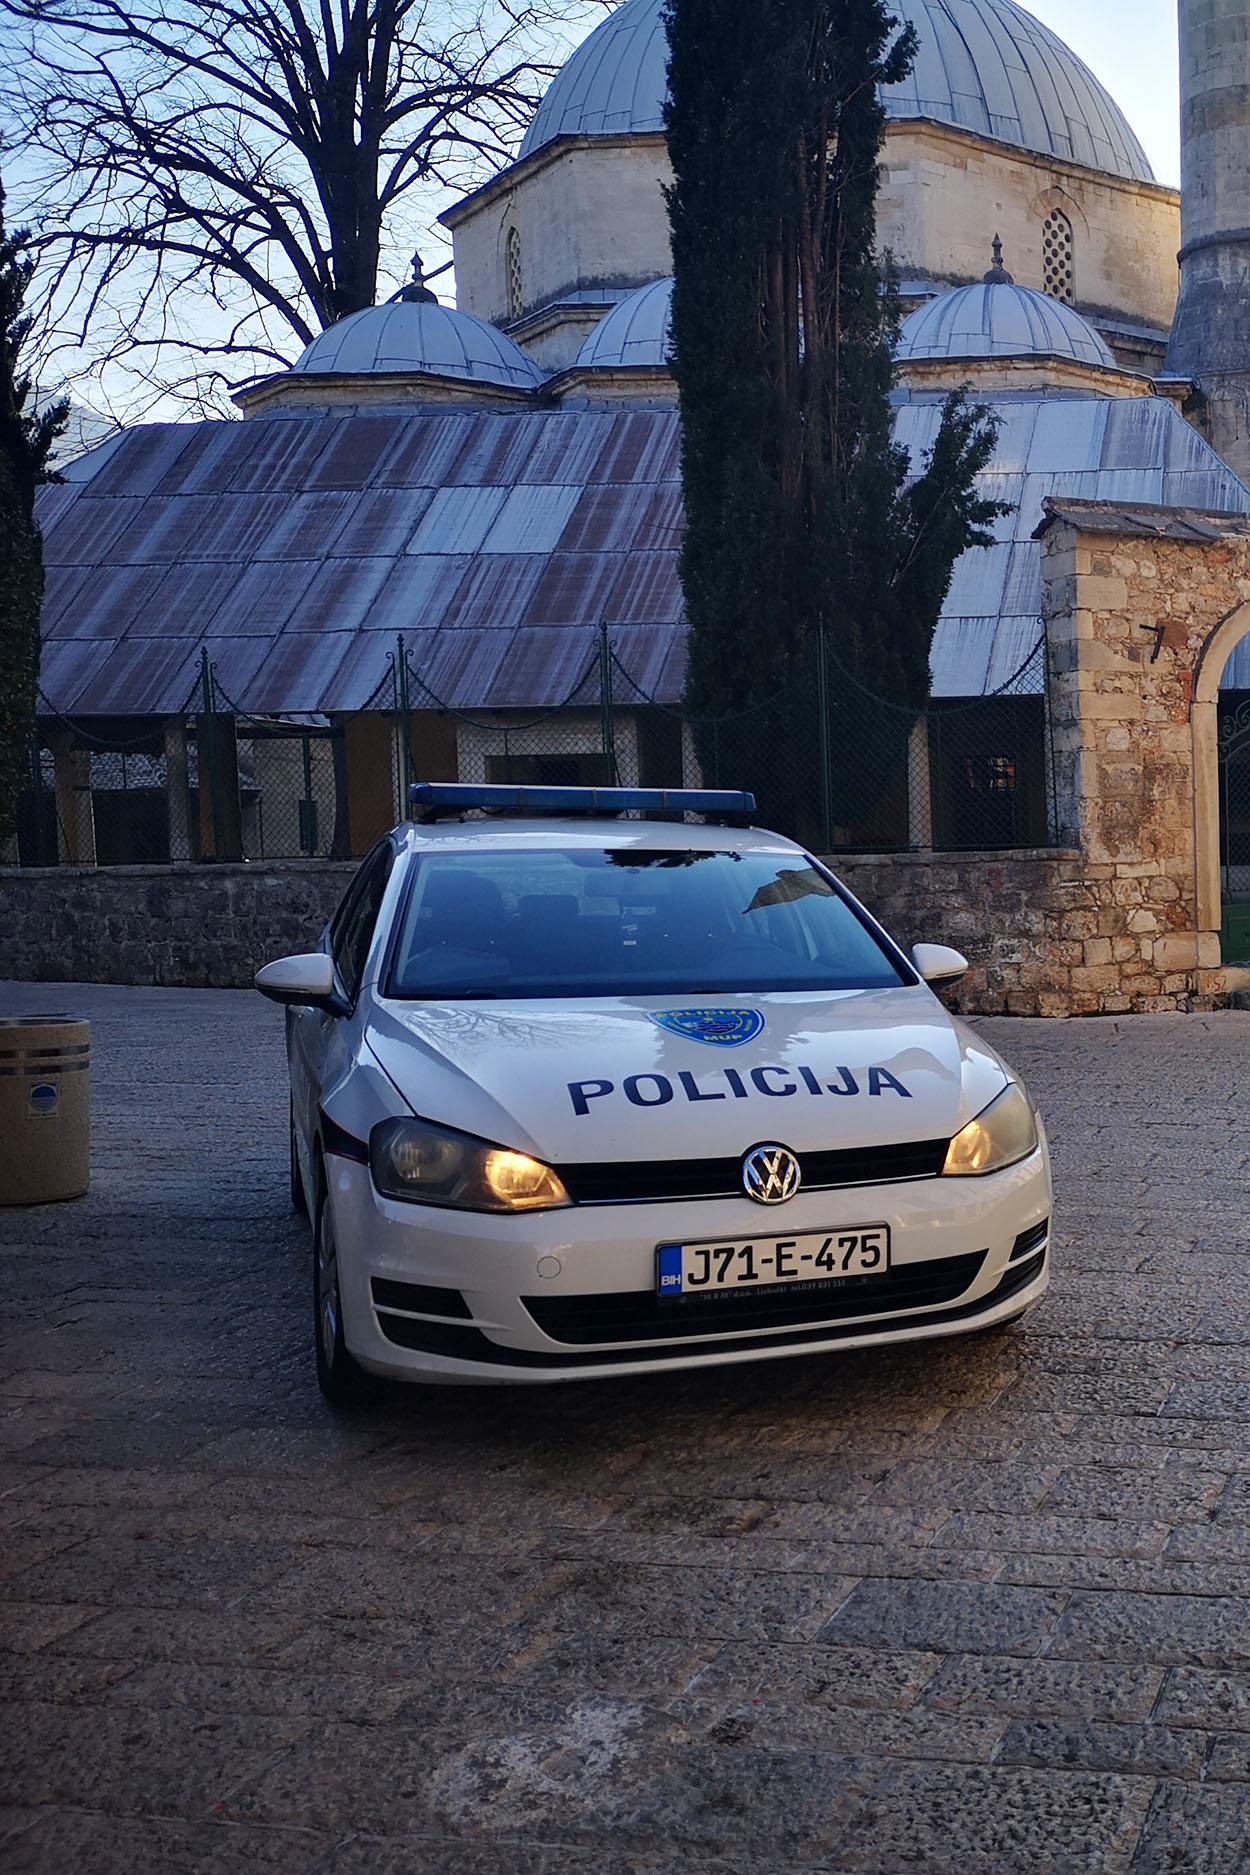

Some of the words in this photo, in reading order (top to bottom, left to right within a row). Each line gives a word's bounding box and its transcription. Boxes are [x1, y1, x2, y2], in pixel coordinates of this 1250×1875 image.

[655, 1009, 751, 1020] POLICIJA
[567, 1066, 913, 1116] POLICIJA
[661, 1273, 682, 1287] BIH
[688, 1233, 882, 1286] J71-E-475
